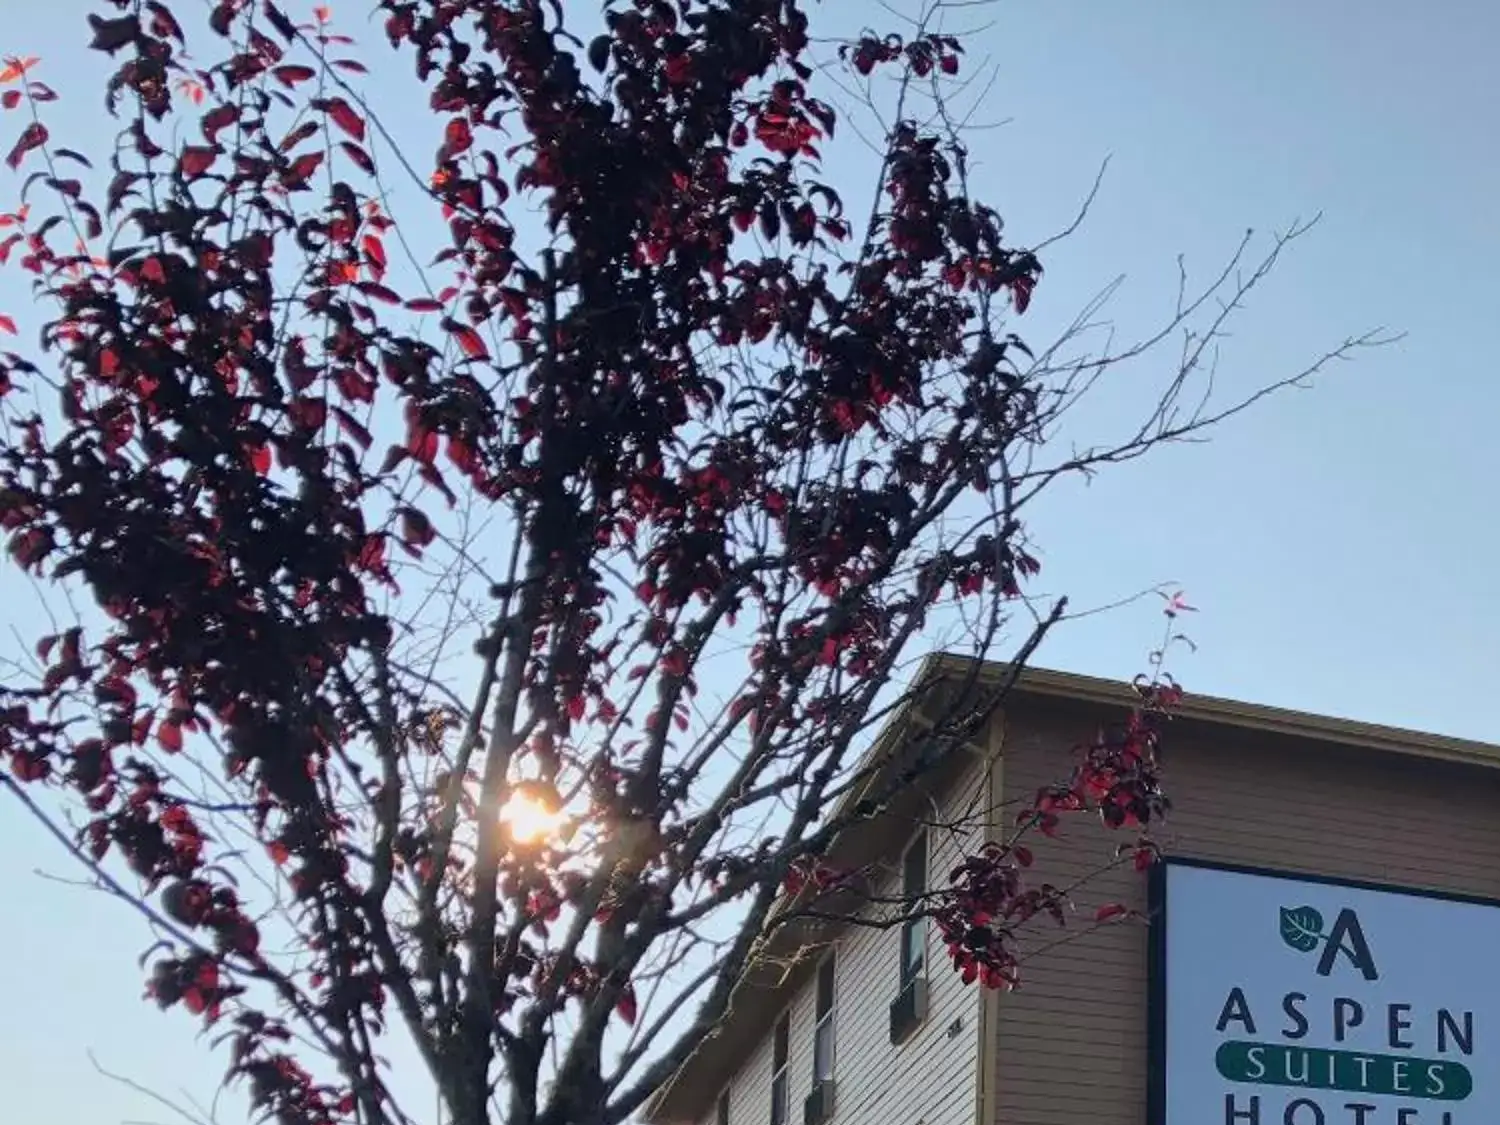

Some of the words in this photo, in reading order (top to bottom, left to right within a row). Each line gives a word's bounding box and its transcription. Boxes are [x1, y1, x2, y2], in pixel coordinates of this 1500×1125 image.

[1316, 907, 1379, 981] A
[1216, 987, 1473, 1055] ASPEN
[1246, 1047, 1446, 1095] SUITES
